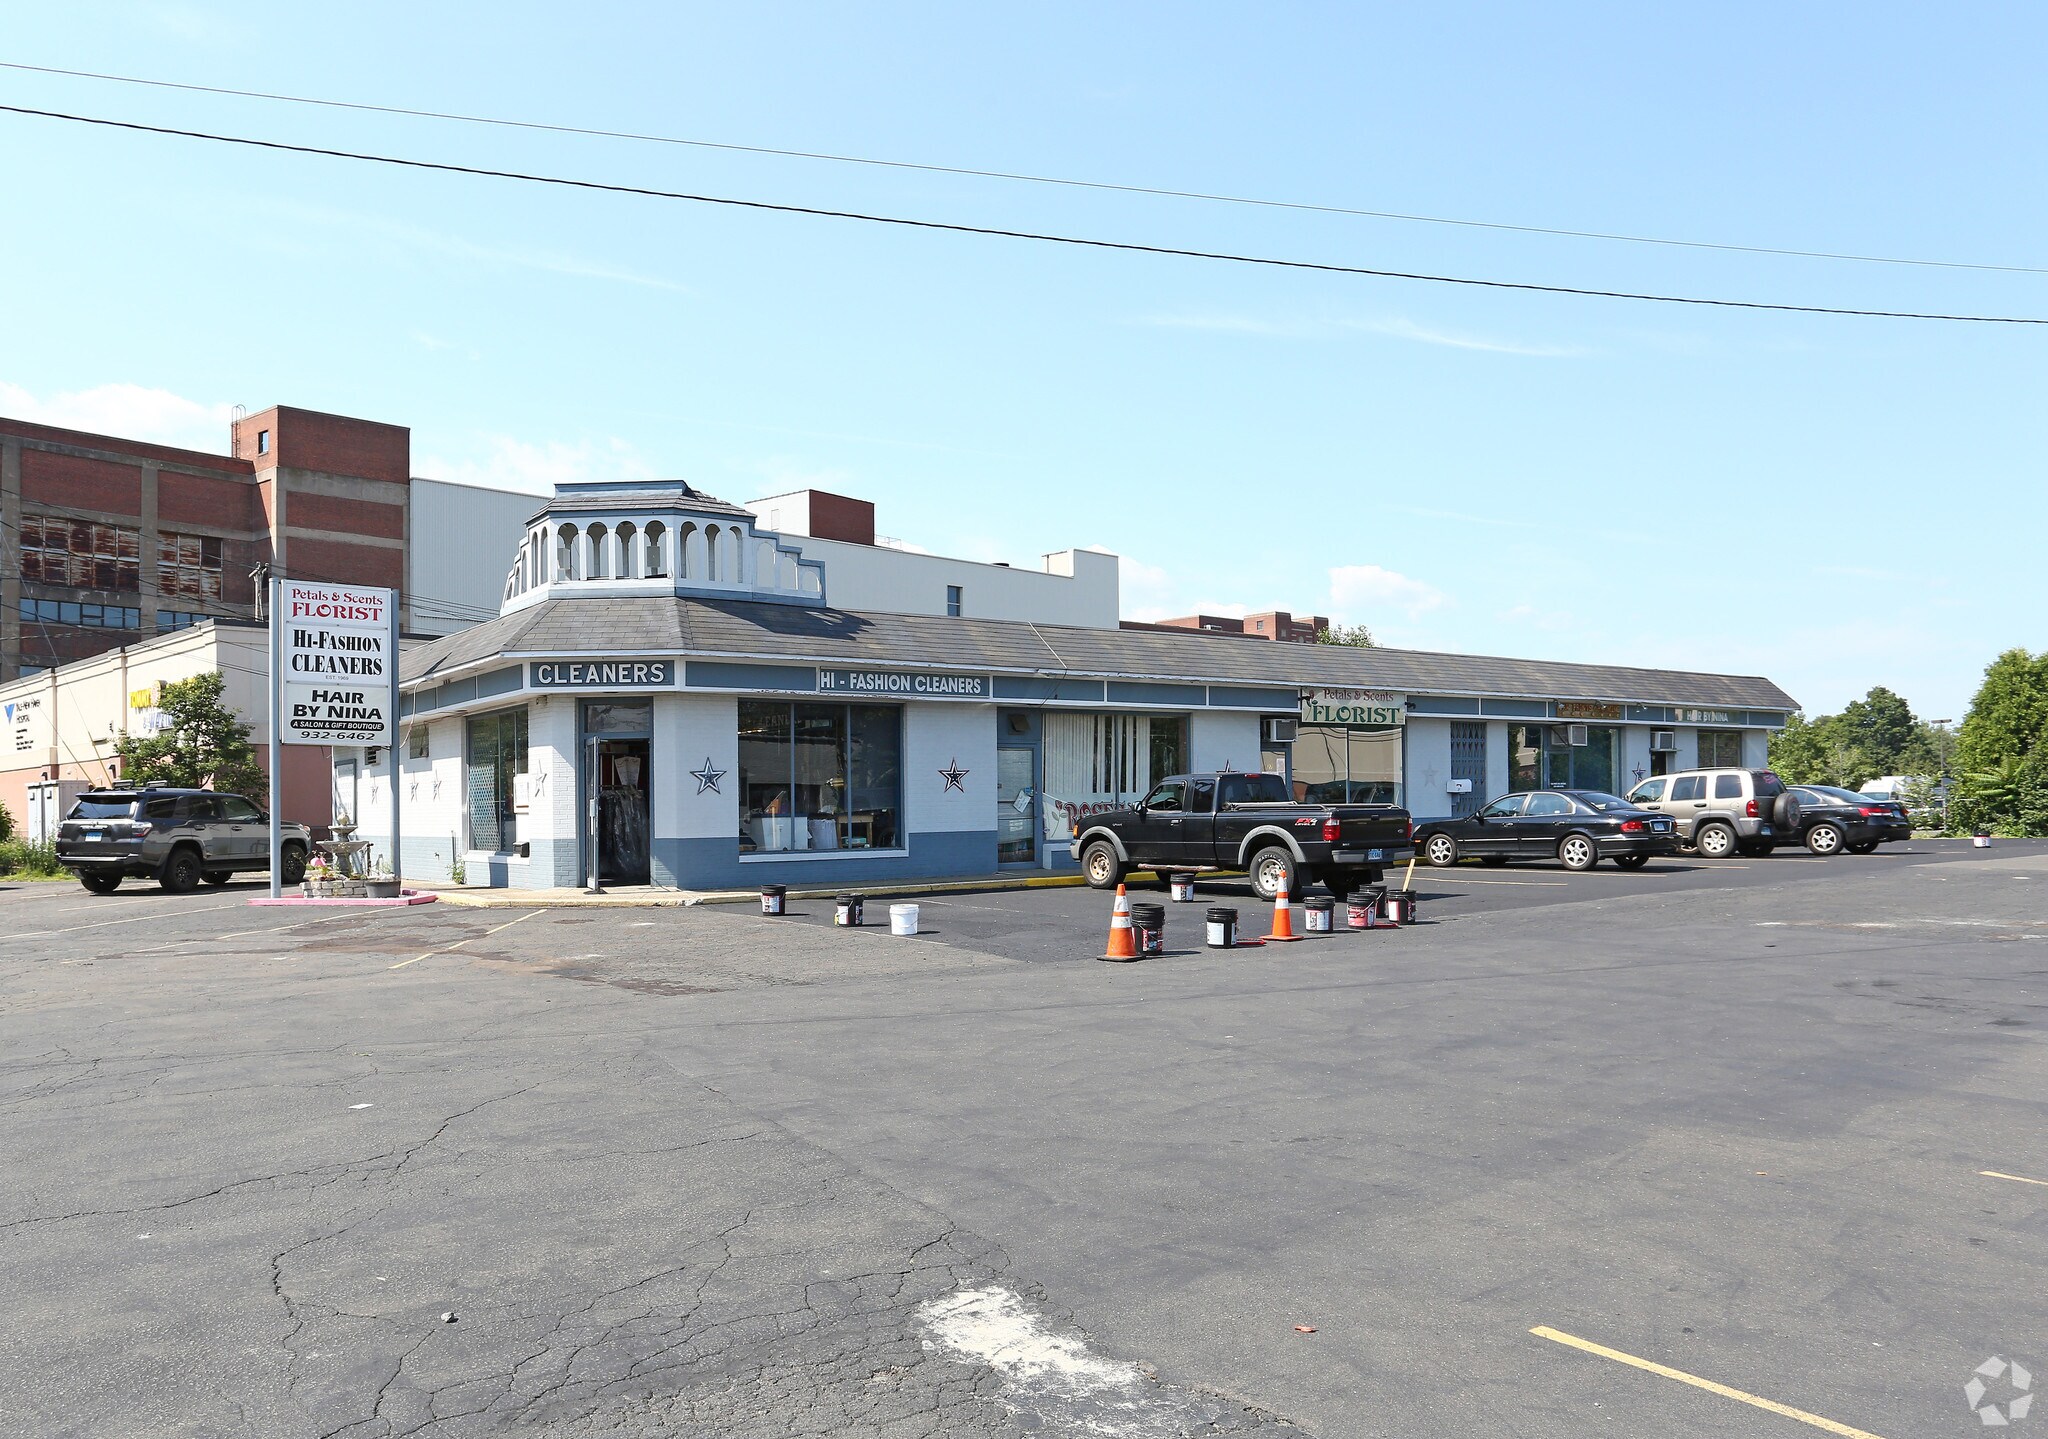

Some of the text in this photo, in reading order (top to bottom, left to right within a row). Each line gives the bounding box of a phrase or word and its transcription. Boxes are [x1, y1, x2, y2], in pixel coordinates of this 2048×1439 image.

[292, 588, 383, 606] Petals & Scents
[291, 602, 383, 621] FLORIST
[292, 653, 383, 675] CLEANERS
[538, 663, 665, 684] CLEANERS
[820, 671, 835, 688] HI
[850, 673, 911, 691] FASHION
[914, 675, 981, 694] CLEANERS
[311, 690, 364, 704] HAIR
[1322, 688, 1394, 702] Petals & Scents
[293, 704, 383, 720] BY NINA
[1312, 705, 1400, 724] FLORIST
[299, 720, 324, 728] SALON
[347, 722, 383, 730] BOUTIQUE
[300, 731, 375, 741] 932-6462
